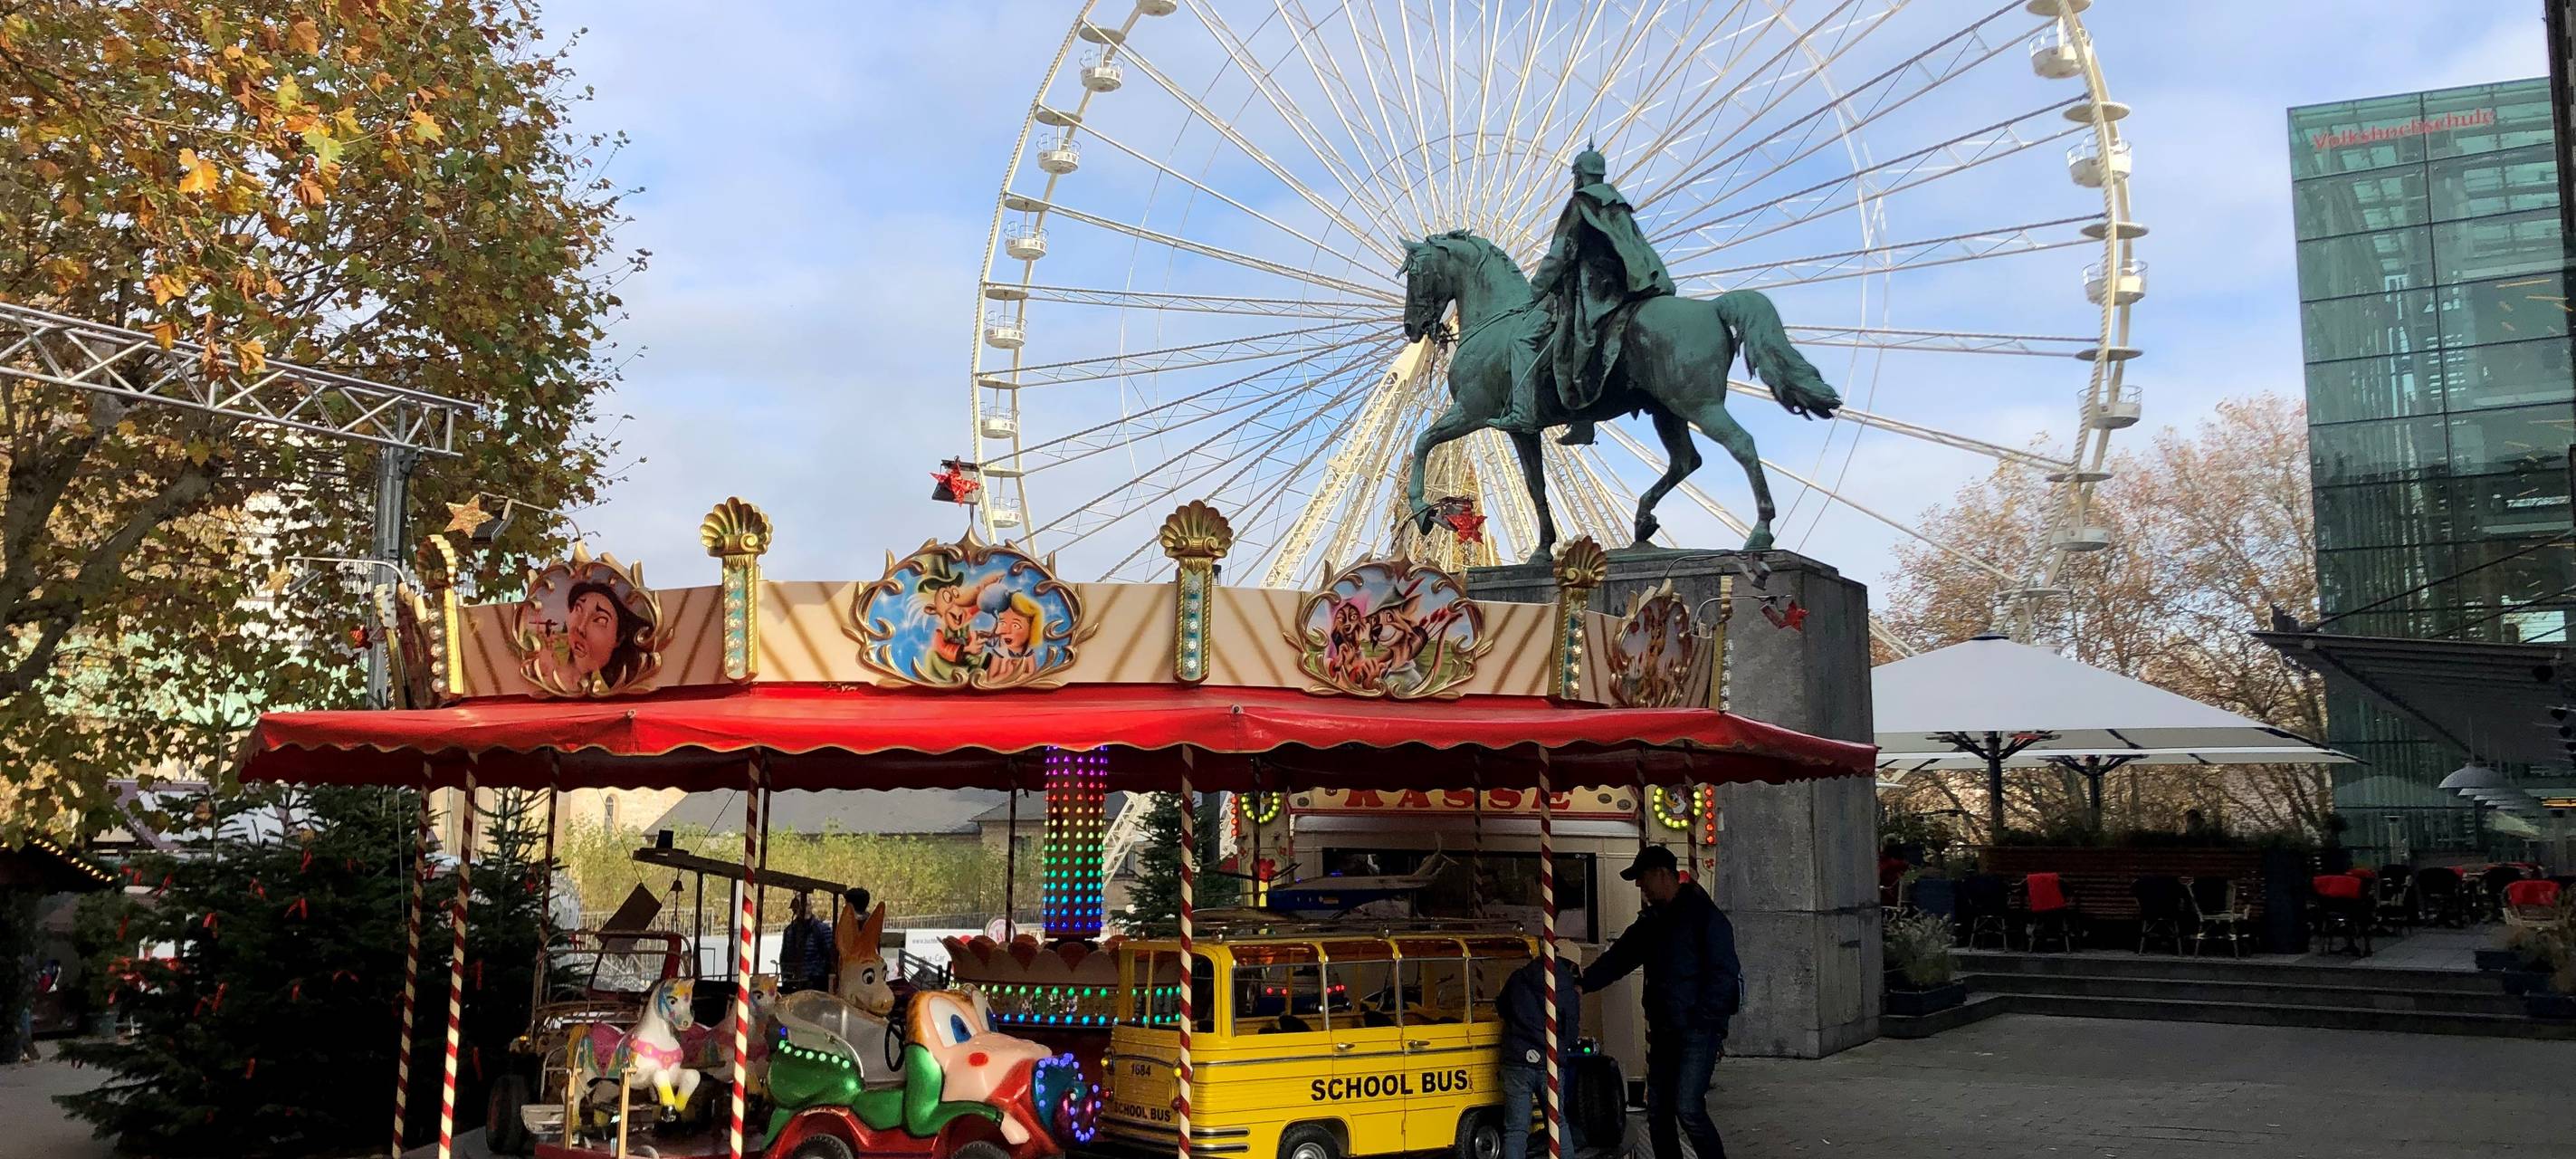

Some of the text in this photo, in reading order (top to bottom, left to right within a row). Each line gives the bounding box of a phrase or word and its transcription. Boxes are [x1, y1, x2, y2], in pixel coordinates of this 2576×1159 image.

[2313, 109, 2495, 149] Volkshochschule
[1311, 1069, 1468, 1101] SCHOOL BUS
[1114, 1101, 1170, 1122] SCHOOL BUS
